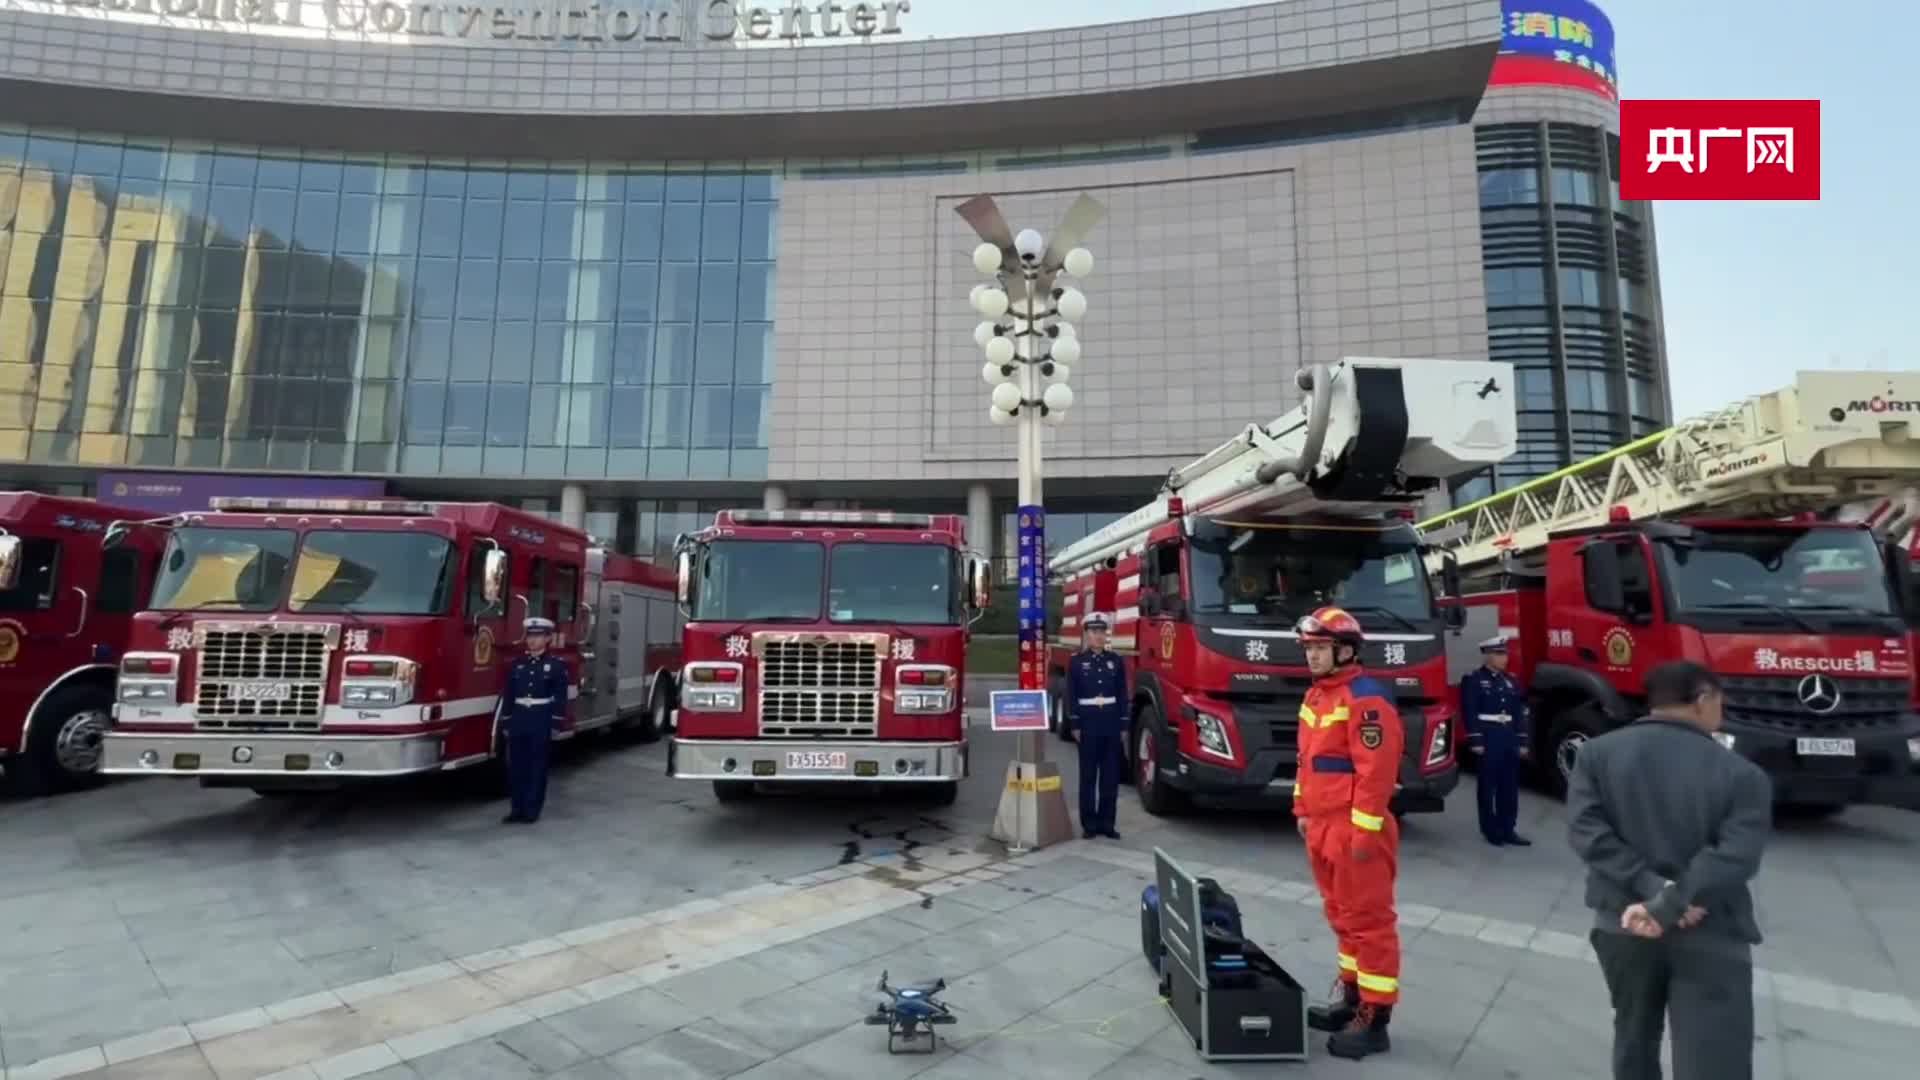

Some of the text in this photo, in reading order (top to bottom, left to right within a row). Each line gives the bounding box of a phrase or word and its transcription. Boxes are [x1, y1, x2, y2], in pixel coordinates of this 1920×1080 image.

[324, 0, 682, 42] Convention
[702, 0, 910, 41] Center
[1502, 12, 1593, 48] 消防
[167, 628, 368, 651] 救 援
[726, 634, 915, 660] 救 援
[1547, 629, 1574, 647] 消防
[1245, 640, 1407, 665] 救 援
[1779, 657, 1856, 671] RESCUE
